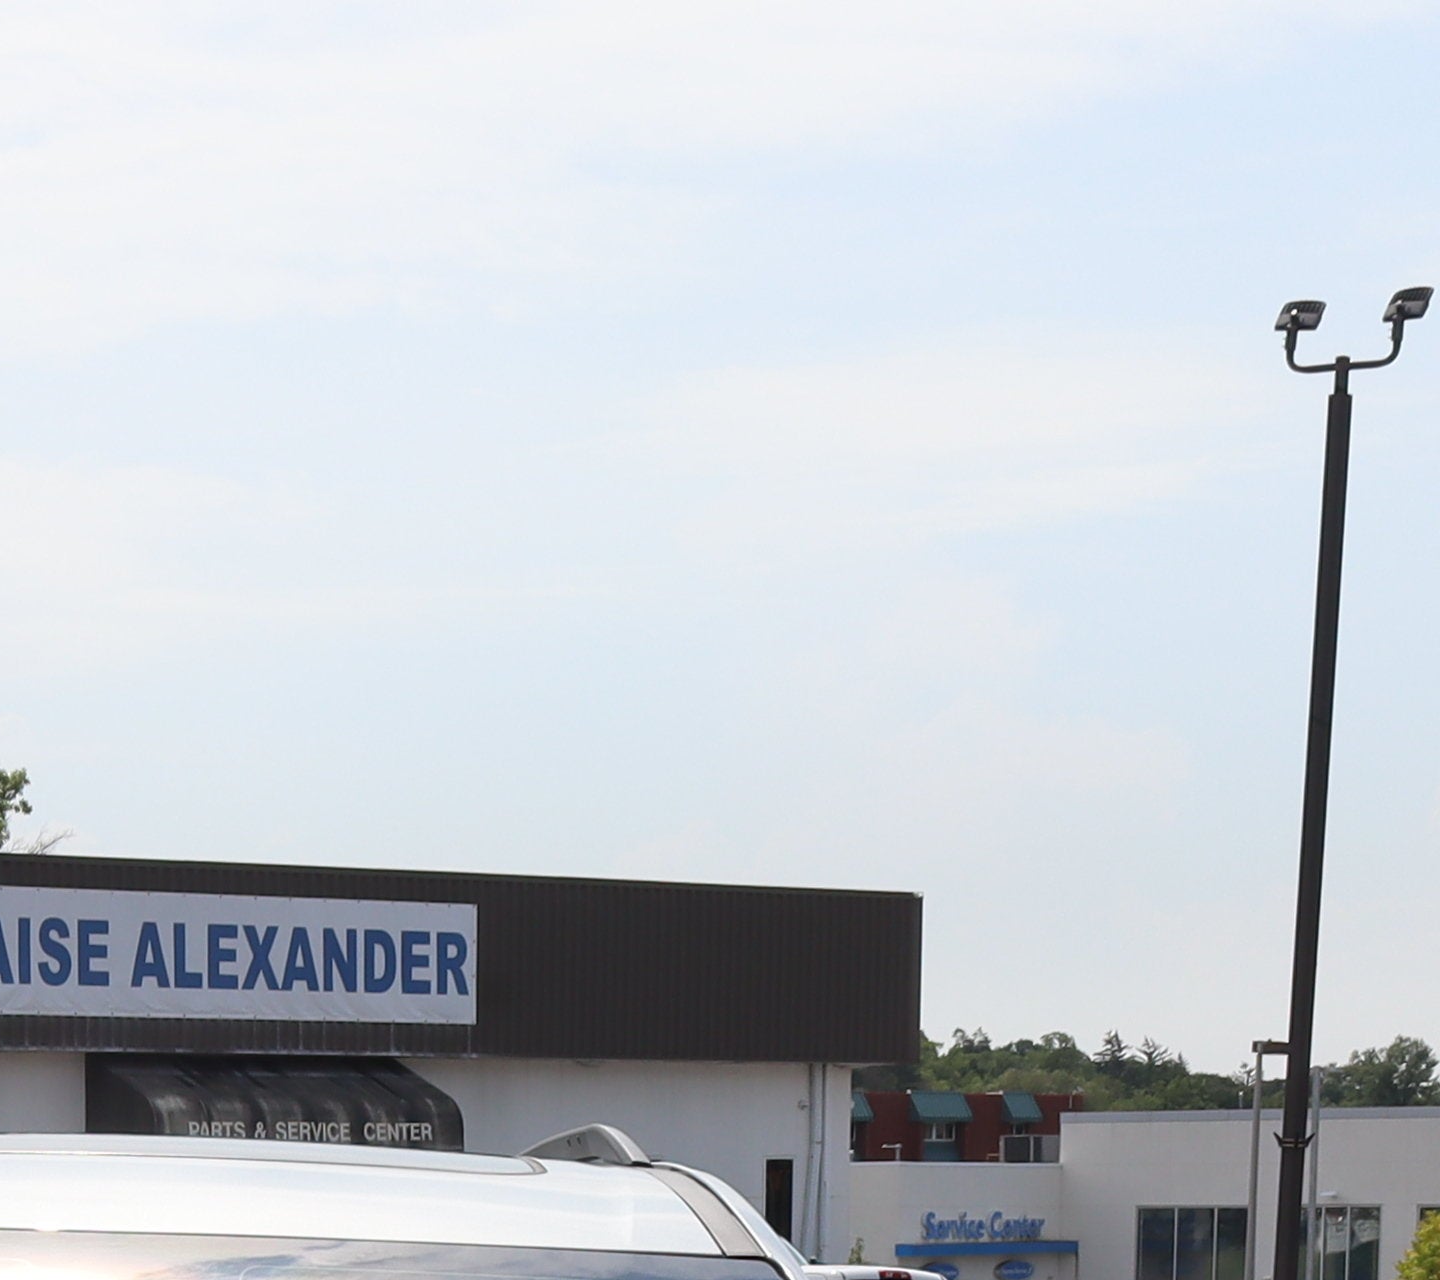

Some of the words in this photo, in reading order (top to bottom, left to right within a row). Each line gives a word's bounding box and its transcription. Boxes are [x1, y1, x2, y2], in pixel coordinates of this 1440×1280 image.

[130, 921, 471, 996] ALEXANDER
[275, 1121, 351, 1142] SERVICE
[363, 1122, 432, 1142] CENTER
[921, 1210, 986, 1241] Service
[989, 1210, 1046, 1240] Center
